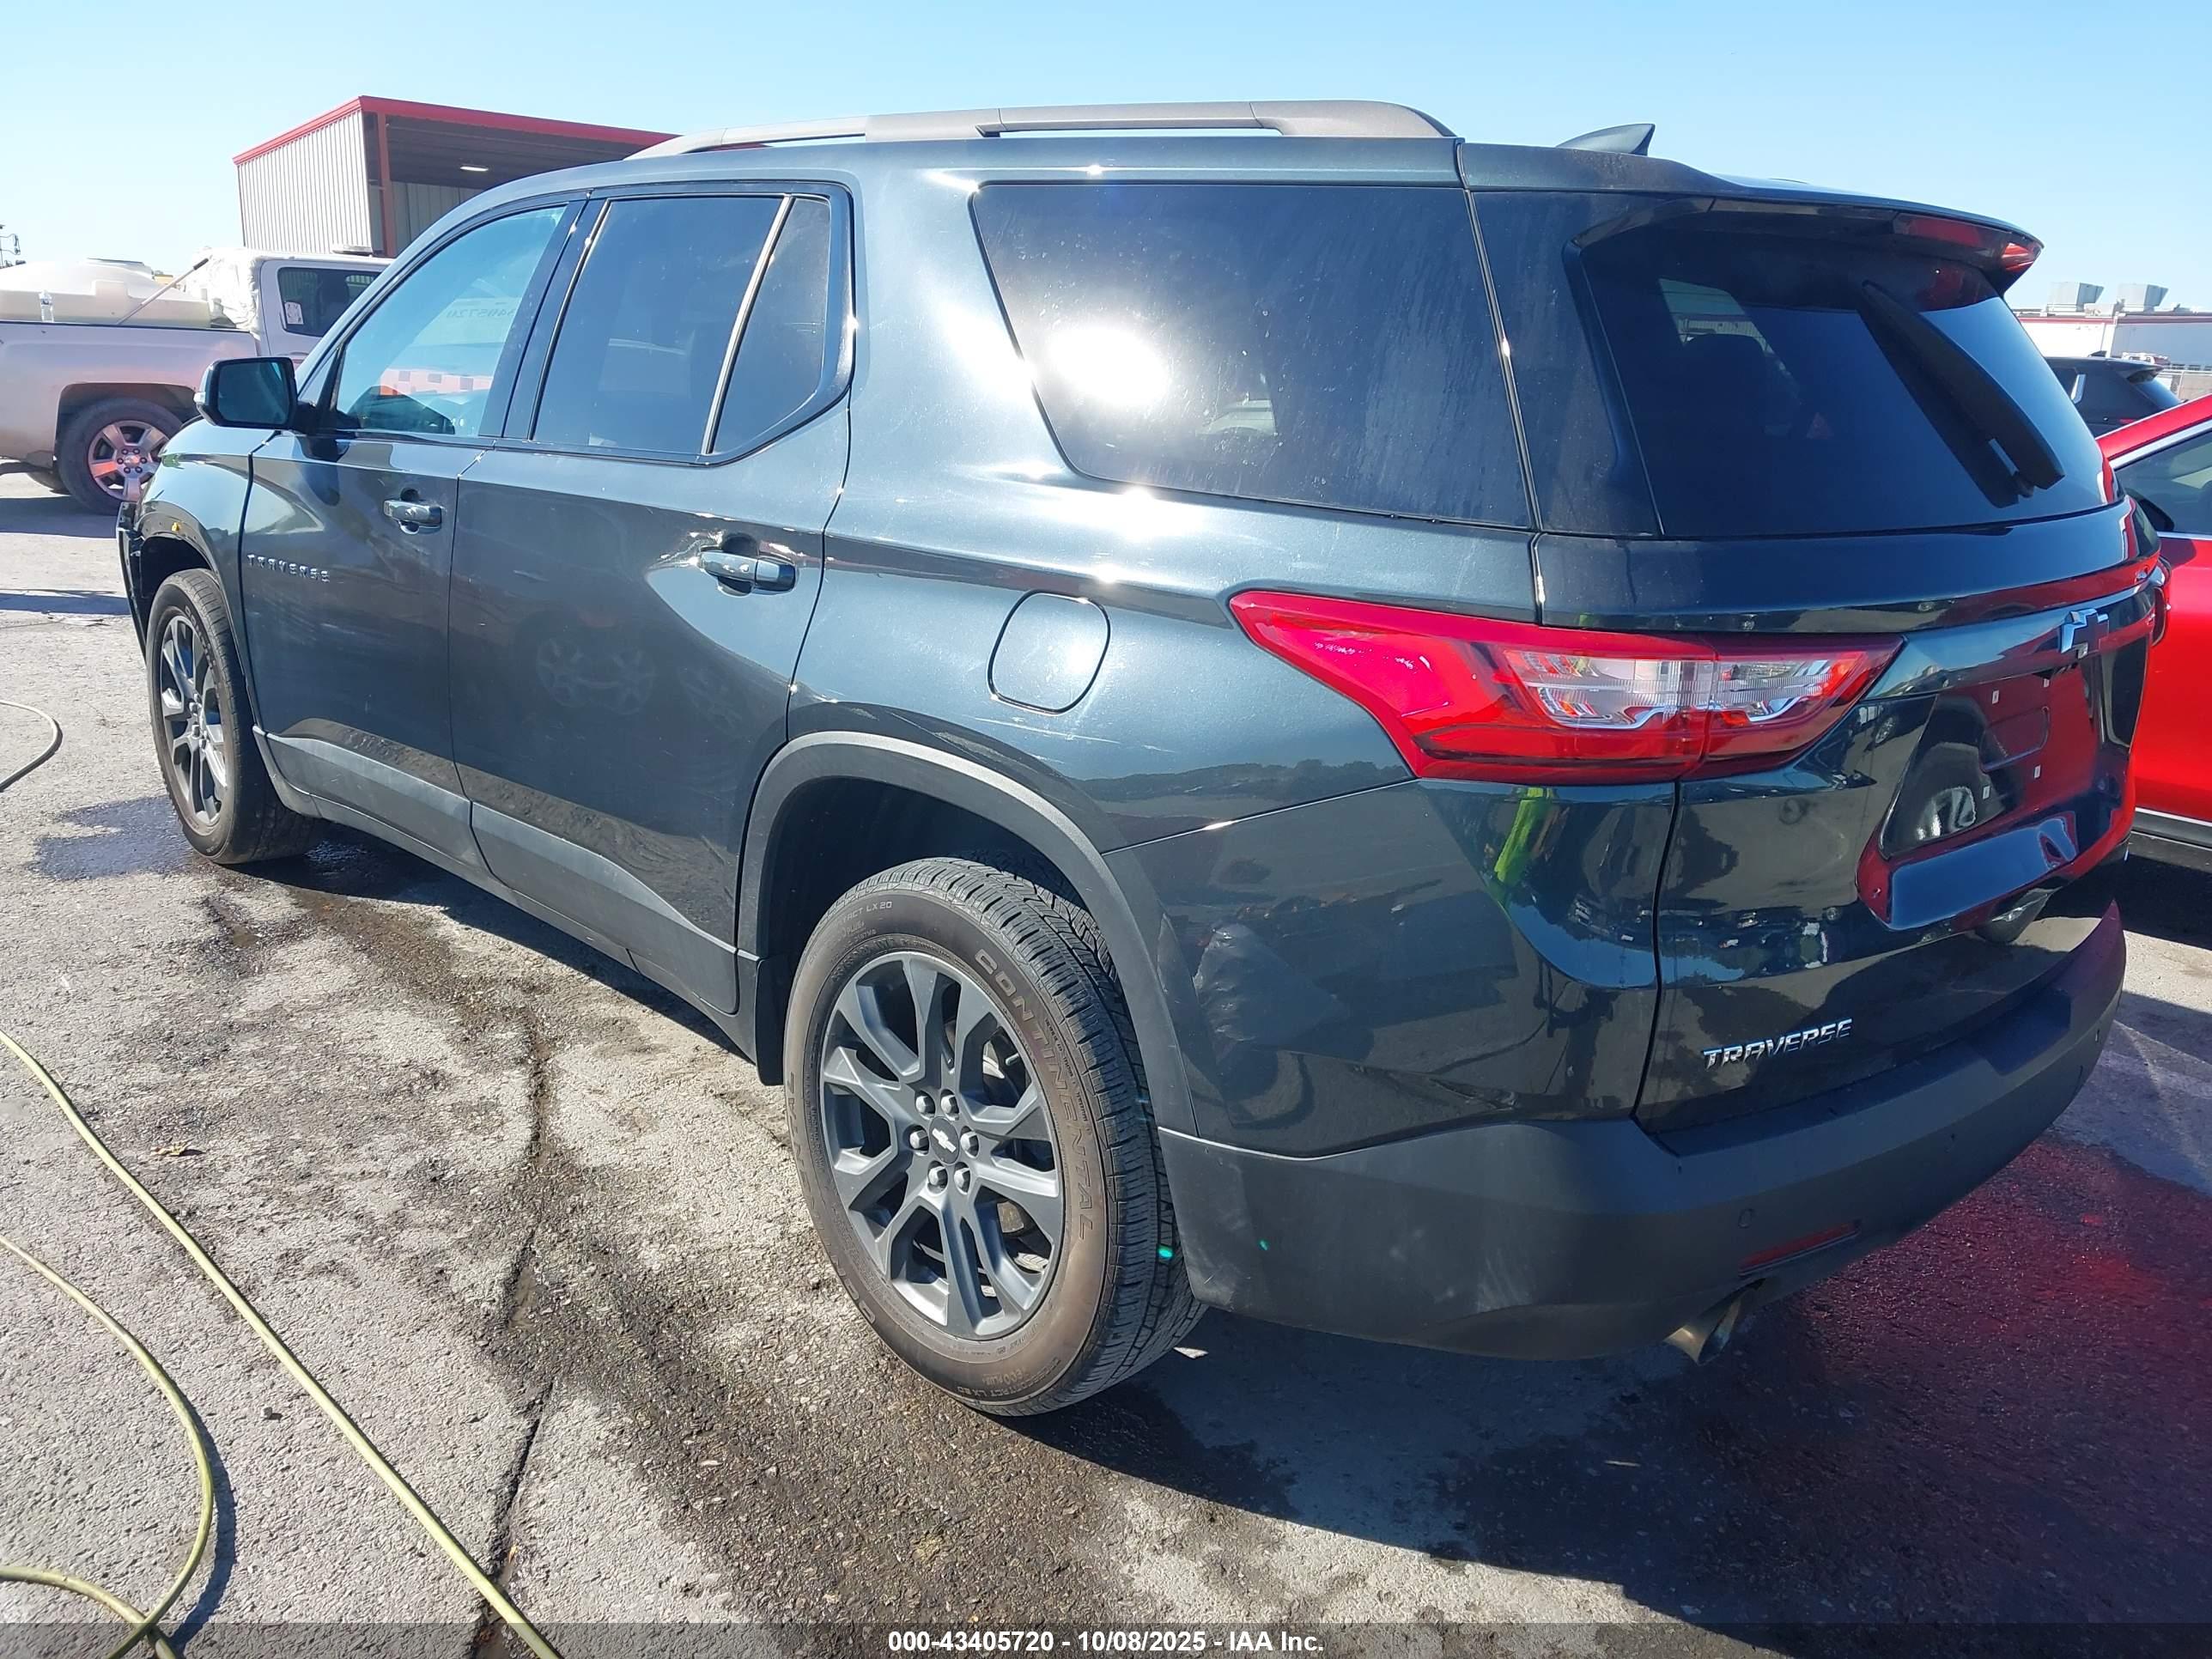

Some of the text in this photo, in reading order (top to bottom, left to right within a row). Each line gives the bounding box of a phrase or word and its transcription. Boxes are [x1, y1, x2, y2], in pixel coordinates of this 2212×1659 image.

[246, 554, 330, 583] TRAVERSE
[1703, 1018, 1853, 1071] TRAVERSE
[975, 948, 1093, 1241] CONTINENTAL
